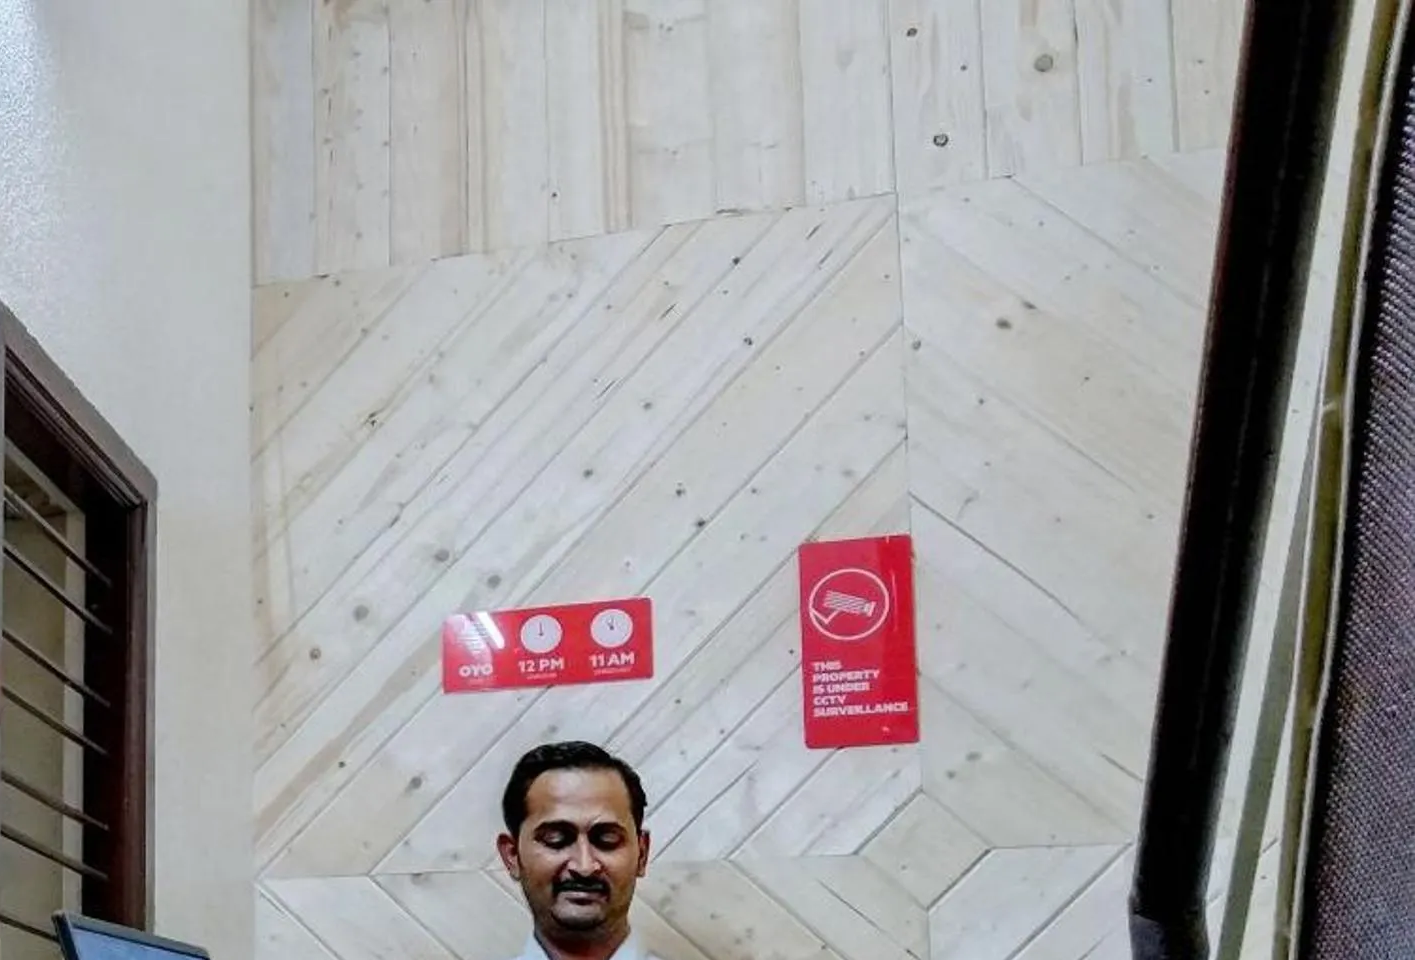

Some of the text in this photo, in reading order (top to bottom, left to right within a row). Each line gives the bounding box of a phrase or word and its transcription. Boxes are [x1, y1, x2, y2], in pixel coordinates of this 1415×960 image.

[518, 657, 565, 673] 12 PM
[589, 651, 635, 667] 11 AM
[458, 663, 494, 677] OYO
[812, 661, 842, 672] THIS
[812, 669, 880, 683] PROPERTY
[812, 682, 871, 694] IS UNDER
[812, 695, 847, 706] CCTV
[812, 701, 909, 718] SURVEILLANCE
